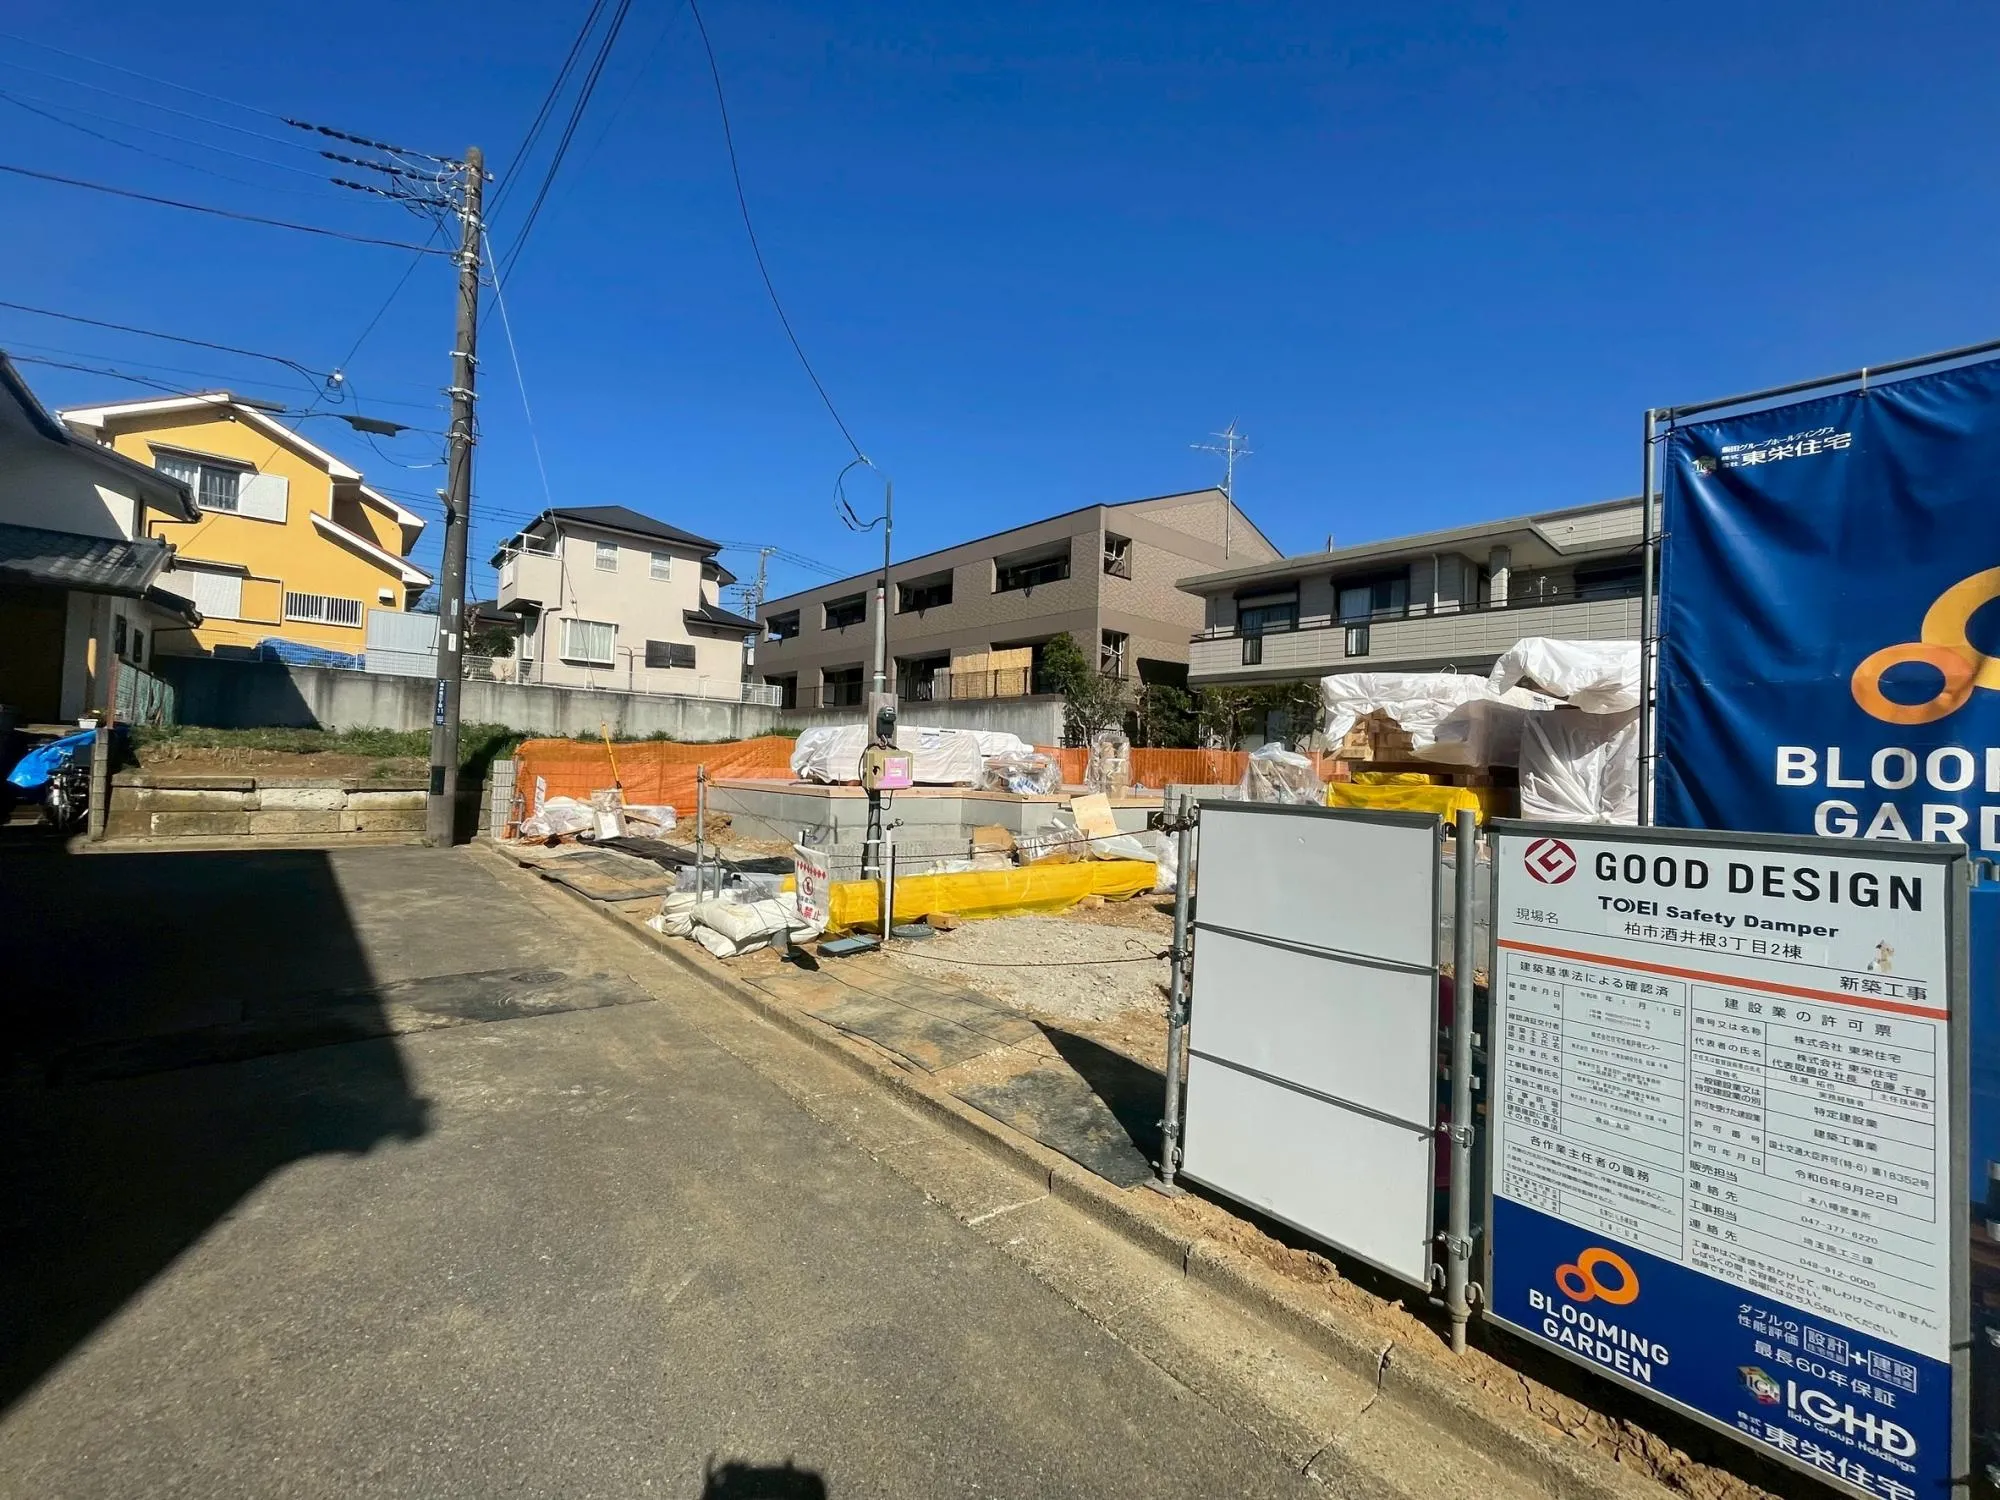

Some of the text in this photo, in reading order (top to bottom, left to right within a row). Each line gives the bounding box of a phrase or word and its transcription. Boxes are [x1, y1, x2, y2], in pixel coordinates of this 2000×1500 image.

[1741, 432, 1852, 466] 東栄住宅
[1595, 851, 1922, 912] GOOD DESIGN
[1516, 906, 1558, 925] 現場名
[1666, 905, 1735, 929] Safety
[1744, 914, 1838, 941] Damper
[1624, 921, 1802, 960] 柏市酒井根3丁目2棟
[1520, 961, 1668, 997] 建築基準法による確認済
[1839, 975, 1927, 1003] 新築工事
[1695, 1015, 1761, 1036] 商号又は名称
[1725, 997, 1891, 1037] 建設業の許可票
[1695, 1036, 1760, 1057] 代表者の氏名
[1794, 1035, 1901, 1064] 株式会社 東栄住宅
[1797, 1053, 1897, 1081] 株式会社 東栄住宅
[1833, 1070, 1856, 1084] 社長
[1814, 1106, 1878, 1129] 特定建設業
[1530, 1135, 1649, 1182] 各作業主任者の職務
[1689, 1160, 1737, 1182] 販売担当
[1689, 1179, 1737, 1202] 連絡先
[1794, 1168, 1897, 1206] 令和6年9月22日
[1689, 1198, 1737, 1222] 工事担当
[1689, 1217, 1737, 1242] 連絡先
[1529, 1288, 1669, 1368] BLOOMING
[1737, 1312, 1798, 1347] 性能評価
[1738, 1301, 1798, 1333] ダブルの
[1543, 1316, 1650, 1382] GARDEN
[1808, 1330, 1912, 1381] 設計 建設
[1754, 1338, 1895, 1409] 最長60年保証
[1737, 1409, 1761, 1427] 株式
[1737, 1419, 1761, 1437] 会社
[1787, 1409, 1915, 1475] Iida Group Holdings
[1764, 1423, 1916, 1500] 東栄住宅
